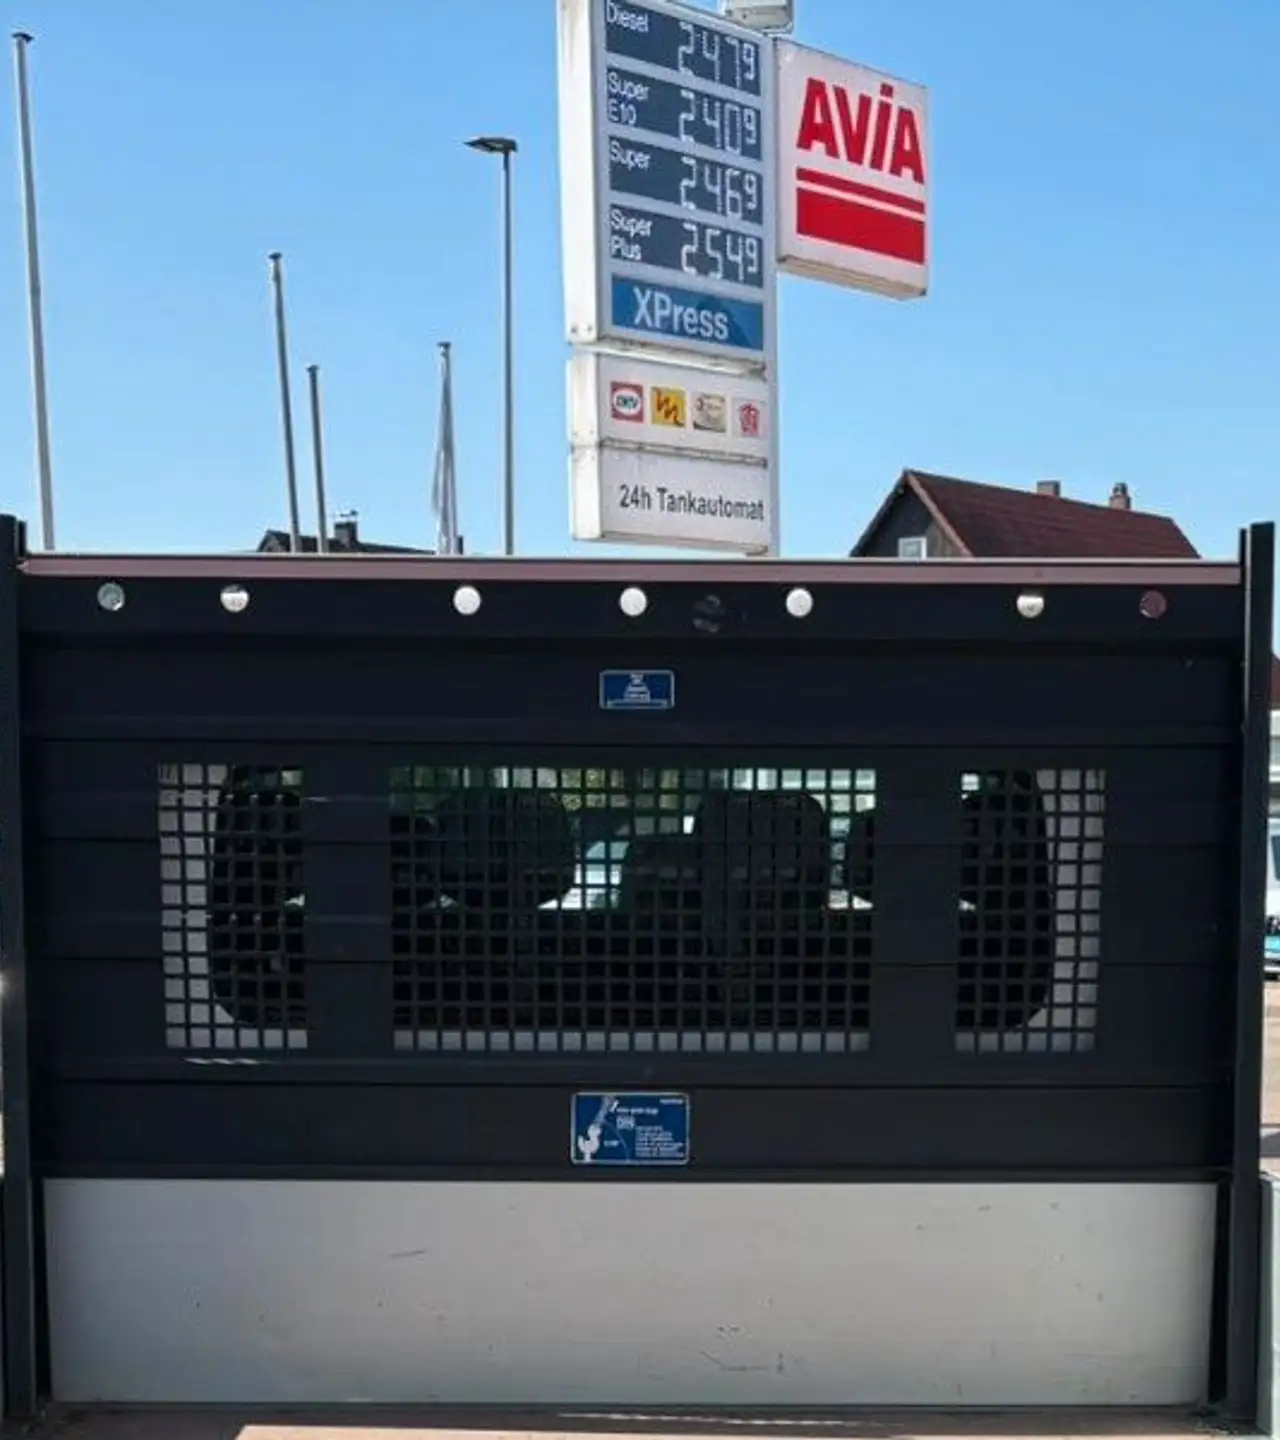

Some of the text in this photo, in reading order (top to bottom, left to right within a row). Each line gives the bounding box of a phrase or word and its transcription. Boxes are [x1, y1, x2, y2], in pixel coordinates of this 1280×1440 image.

[606, 1, 648, 32] Diesel
[607, 72, 649, 100] Super
[608, 99, 636, 126] E10
[610, 141, 651, 171] Super
[610, 209, 652, 237] Super
[611, 235, 641, 261] Plus
[633, 287, 729, 341] XPress
[620, 484, 764, 521] 24h Tankautomat
